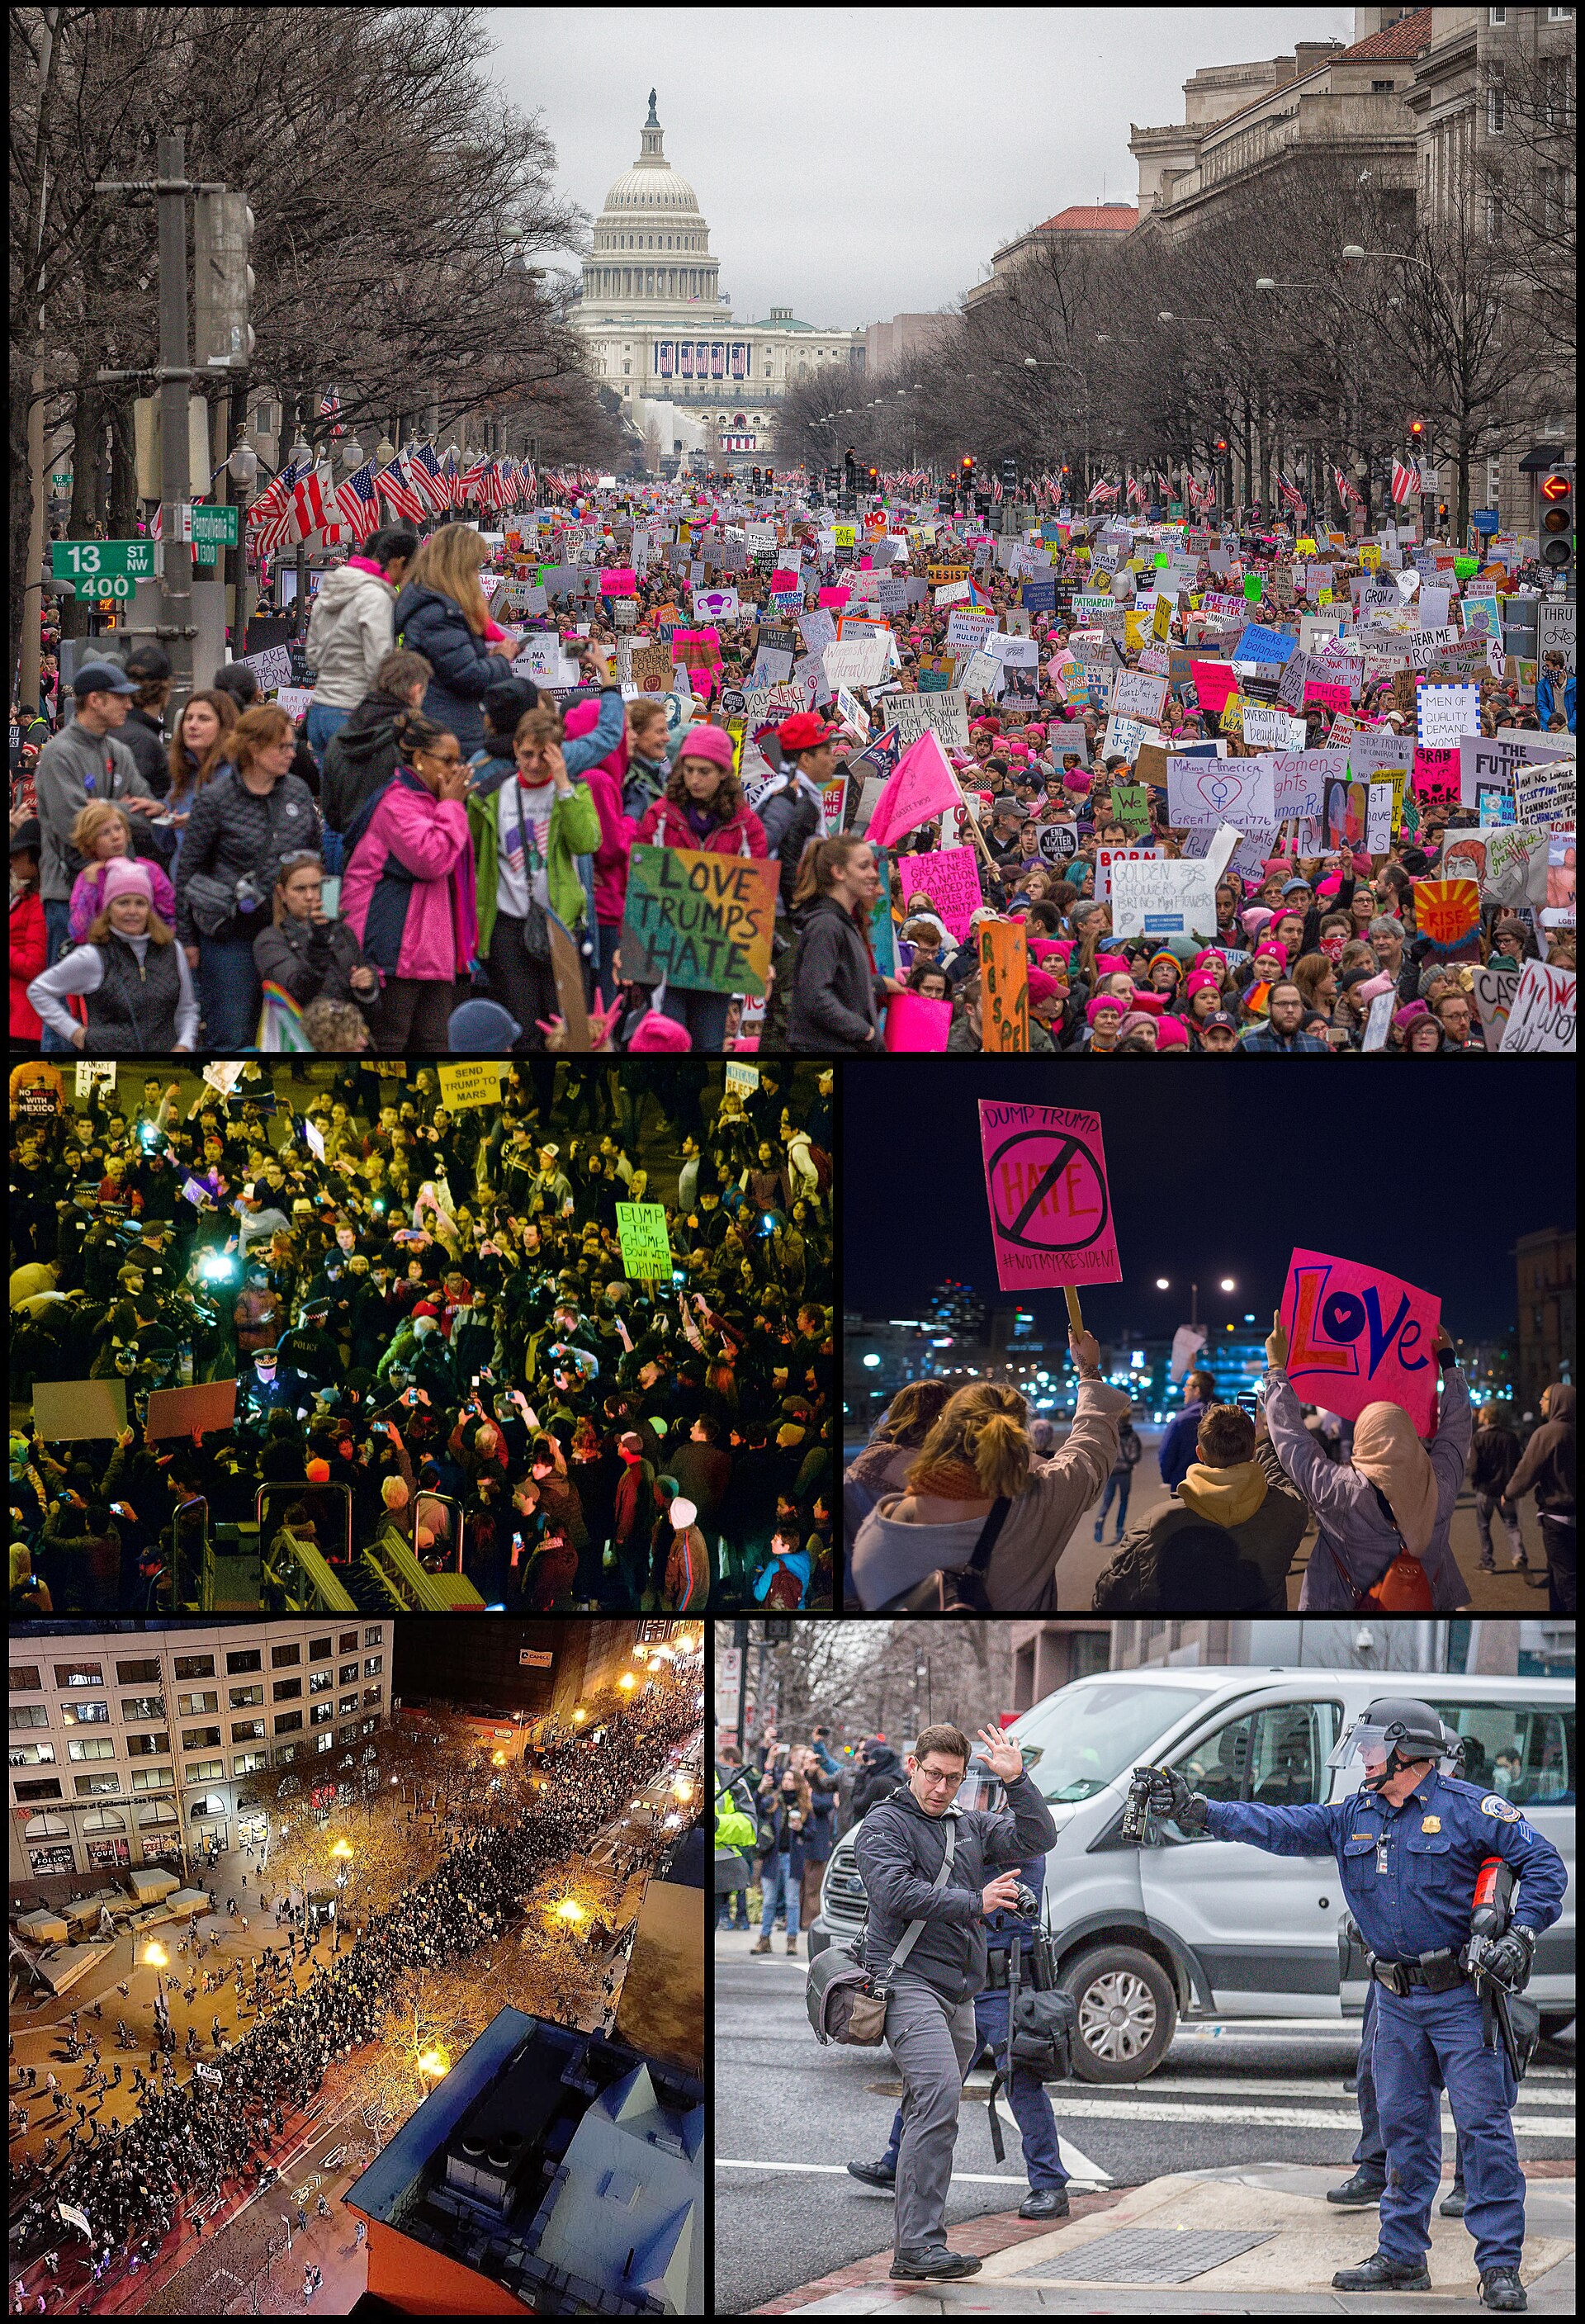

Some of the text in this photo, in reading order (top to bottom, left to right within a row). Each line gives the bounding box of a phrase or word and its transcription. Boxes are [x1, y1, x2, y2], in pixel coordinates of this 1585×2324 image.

[864, 512, 886, 528] HO
[68, 546, 145, 573] 13 ST
[200, 545, 215, 562] 1300
[126, 559, 148, 570] NW
[929, 570, 967, 580] RESIST
[1339, 568, 1361, 580] LOVE
[82, 579, 129, 596] 400
[1074, 597, 1115, 608] PATRIARCHY
[1206, 594, 1247, 608] WE ARE
[1212, 603, 1240, 616] BETTER
[1544, 608, 1573, 621] THRU
[955, 614, 995, 624] AMERICANS
[619, 637, 633, 650] THE
[768, 632, 787, 641] HATE
[1250, 628, 1282, 646] checks
[1410, 629, 1451, 646] HEAR ME
[262, 646, 287, 666] ARE
[632, 645, 671, 656] RESPETA MI
[1091, 645, 1113, 661] SHE
[1246, 639, 1285, 660] balances
[1441, 641, 1479, 656] WOMEN
[255, 665, 272, 676] THE
[632, 666, 673, 678] RESISTENCIA
[255, 668, 291, 691] TORM
[1334, 674, 1360, 687] OFF MY
[1308, 684, 1347, 698] ETHICS
[886, 695, 955, 710] WHEN DID THE
[1426, 696, 1467, 707] MEN OF
[887, 708, 937, 720] DOLLAR
[1244, 708, 1286, 725] DIVERSITY IS
[1426, 712, 1468, 722] QUALITY
[1250, 722, 1289, 747] beautiful
[1426, 724, 1469, 734] DEMAND
[1360, 736, 1408, 750] STOP TRYING
[1427, 737, 1460, 747] WOME
[1369, 750, 1393, 759] CONTROL
[1416, 749, 1451, 764] GRAB
[1498, 743, 1527, 758] THE
[1208, 759, 1264, 772] America
[1521, 769, 1573, 788] AM NO LONGER
[1118, 791, 1142, 810] We
[1419, 787, 1458, 805] BACK
[1519, 785, 1557, 803] ACCEPTING
[1526, 799, 1552, 814] CANNOT
[1115, 811, 1148, 826] deserve
[1246, 816, 1271, 826] 1776
[1531, 810, 1564, 825] CHANGING
[1050, 828, 1062, 836] END
[920, 850, 970, 866] THE TRUE
[911, 859, 972, 878] GREATNESS
[1114, 863, 1171, 883] GOLDEN
[659, 853, 759, 902] LOVE
[912, 870, 975, 888] OF A NATION
[1115, 882, 1176, 898] SHOWERS
[635, 892, 762, 940] TRUMPS
[1428, 910, 1464, 926] RISE
[645, 934, 750, 979] HATE
[455, 1067, 483, 1077] SEND
[445, 1077, 496, 1091] TRUMP TO
[457, 1090, 486, 1101] MARS
[985, 1105, 1099, 1134] DUMP TRUMP
[1001, 1162, 1098, 1218] HATE
[620, 1206, 663, 1224] BUMP
[629, 1225, 652, 1233] THE
[625, 1247, 669, 1259] DOWN WITH
[1002, 1248, 1115, 1272] #NOTMYPRESIDENT
[59, 1804, 88, 1812] Institute
[143, 1842, 175, 1851] PASSION
